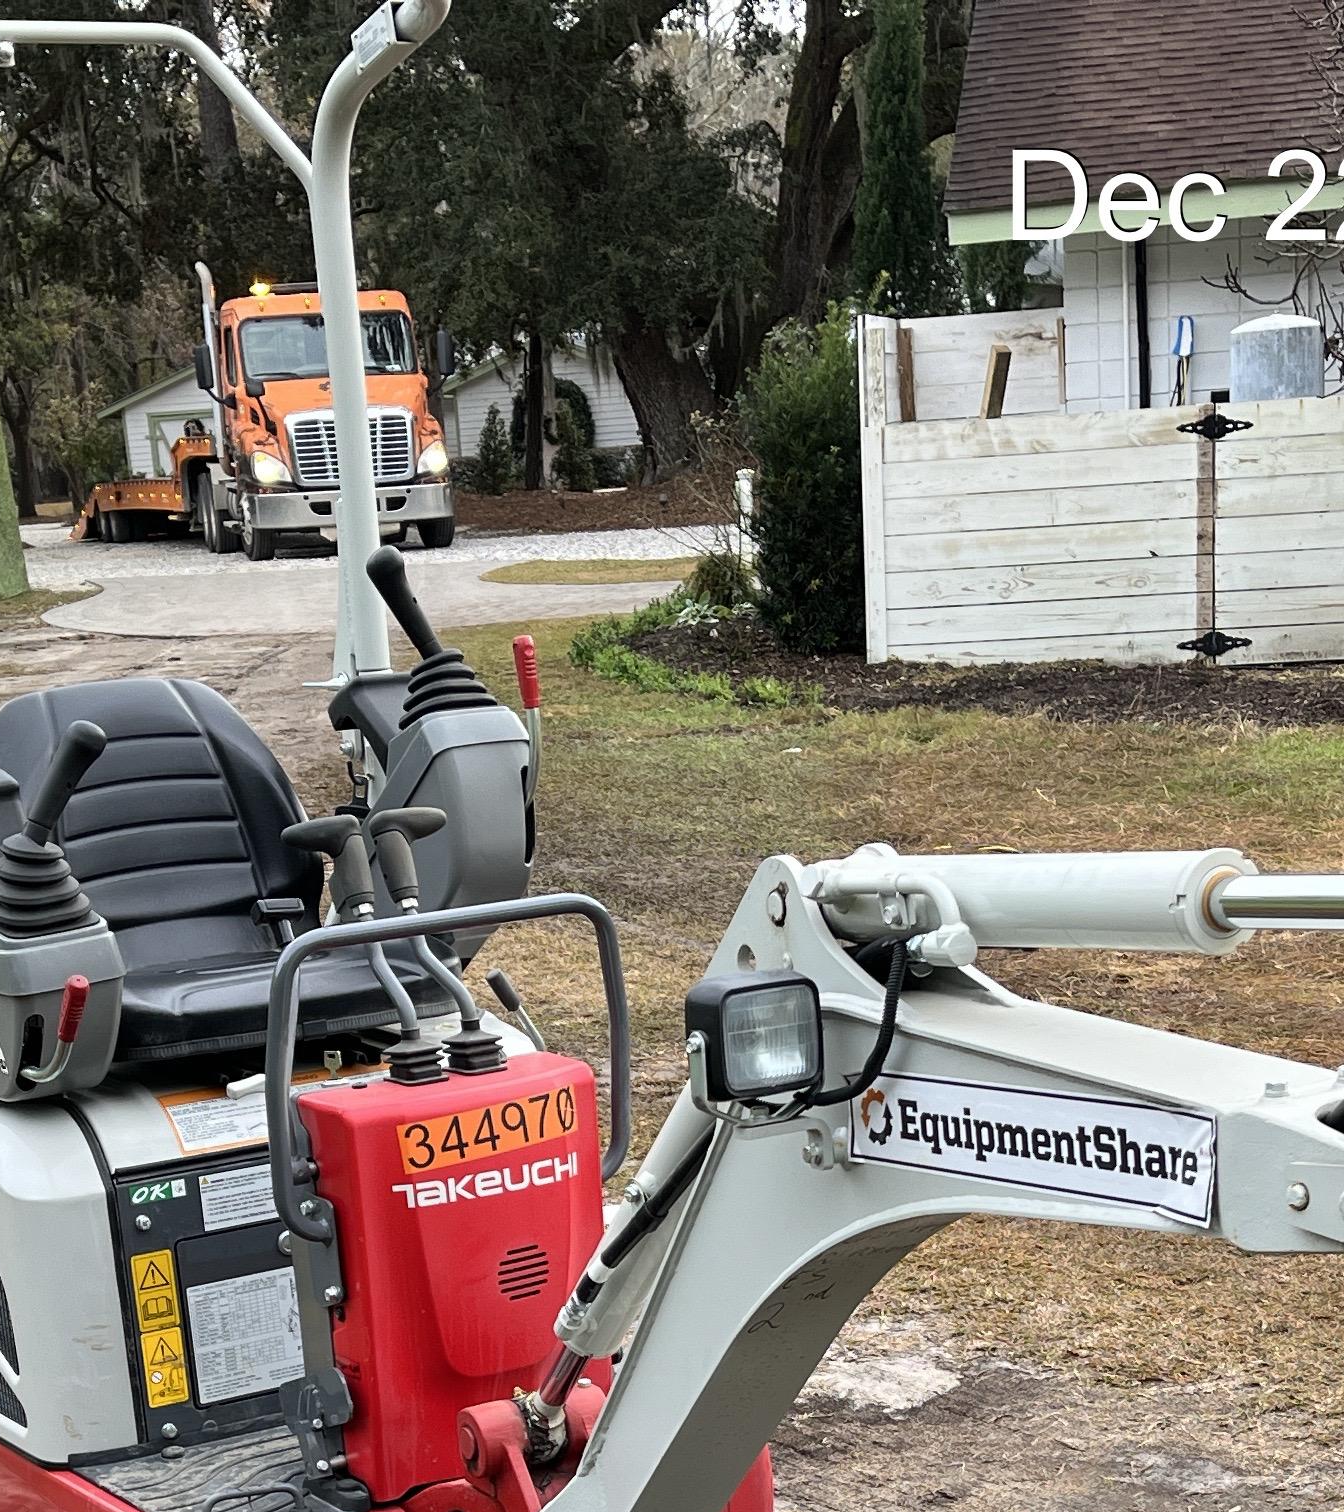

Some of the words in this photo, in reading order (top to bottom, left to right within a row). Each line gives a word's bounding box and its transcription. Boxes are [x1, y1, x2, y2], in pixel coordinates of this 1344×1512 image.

[404, 1085, 575, 1169] 344970
[897, 1098, 1198, 1186] EquipmentShare
[131, 1182, 170, 1204] OK
[392, 1151, 578, 1209] TAKEUCHI
